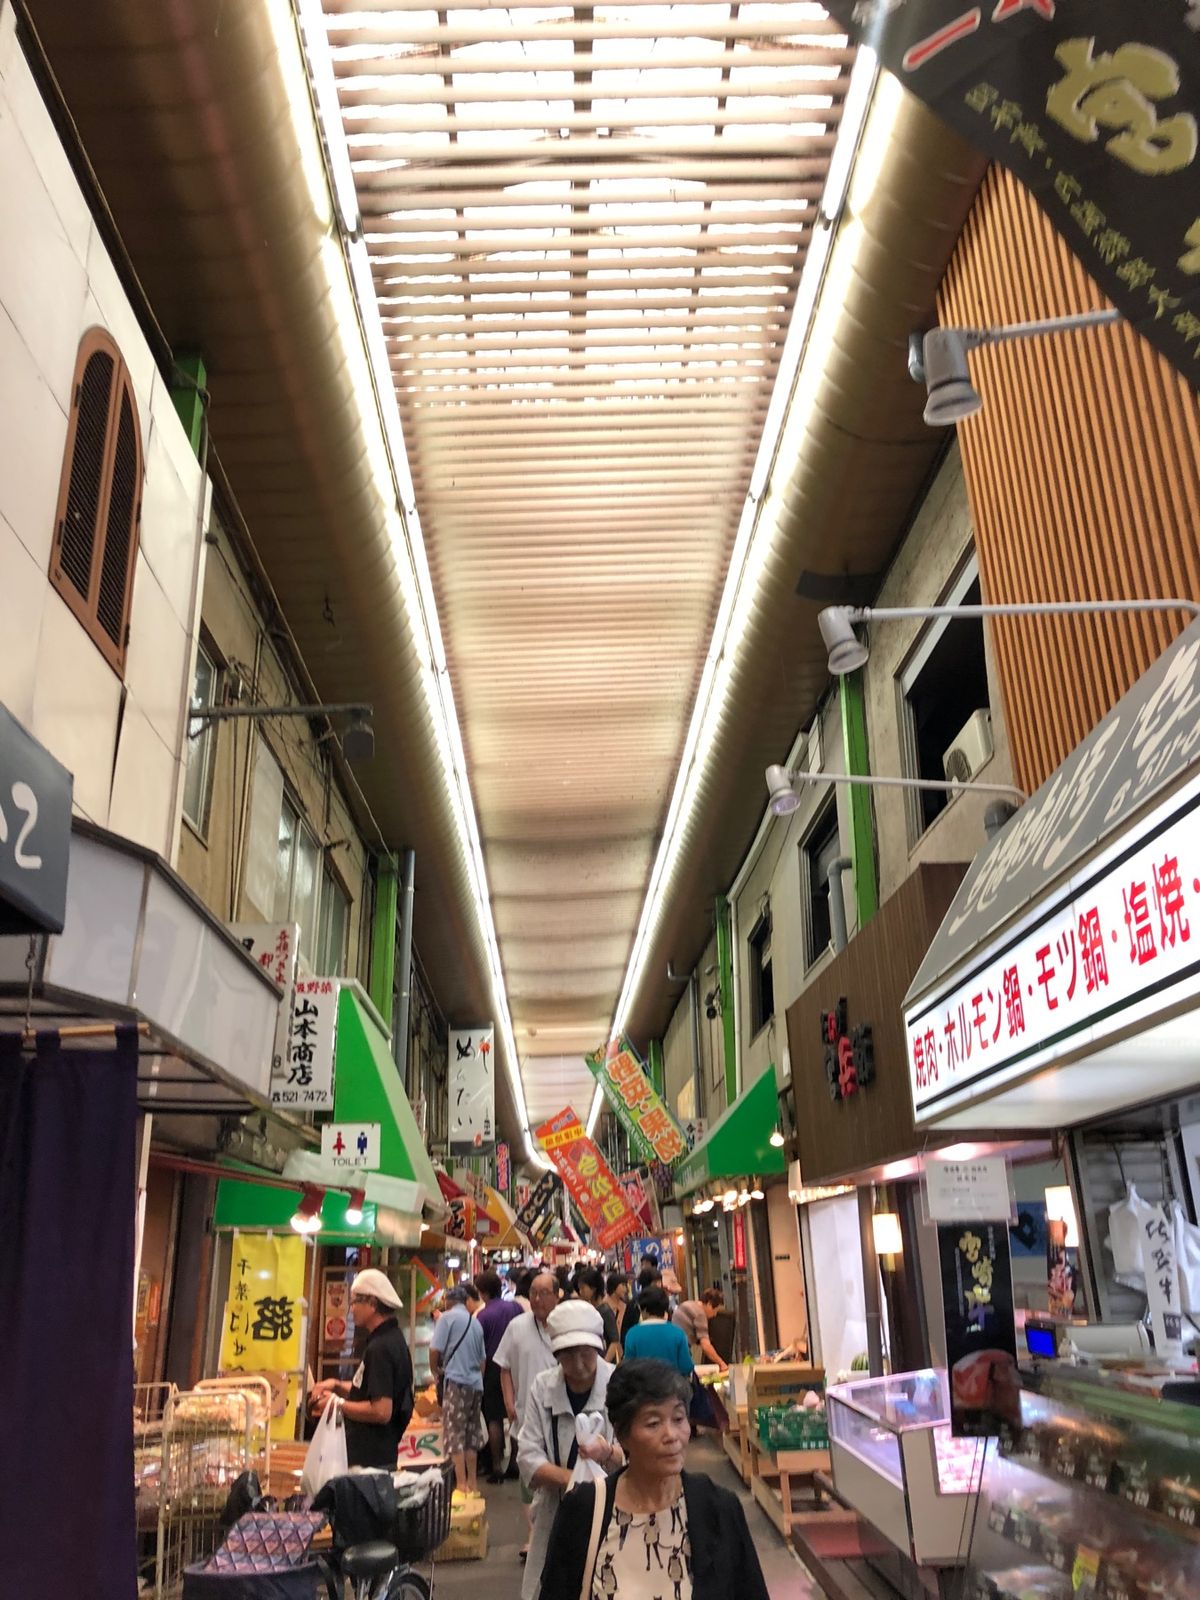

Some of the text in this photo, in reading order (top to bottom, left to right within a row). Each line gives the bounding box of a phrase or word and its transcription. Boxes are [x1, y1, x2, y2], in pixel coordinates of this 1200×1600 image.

[287, 999, 319, 1086] 山本商店
[332, 1157, 369, 1168] TOILET
